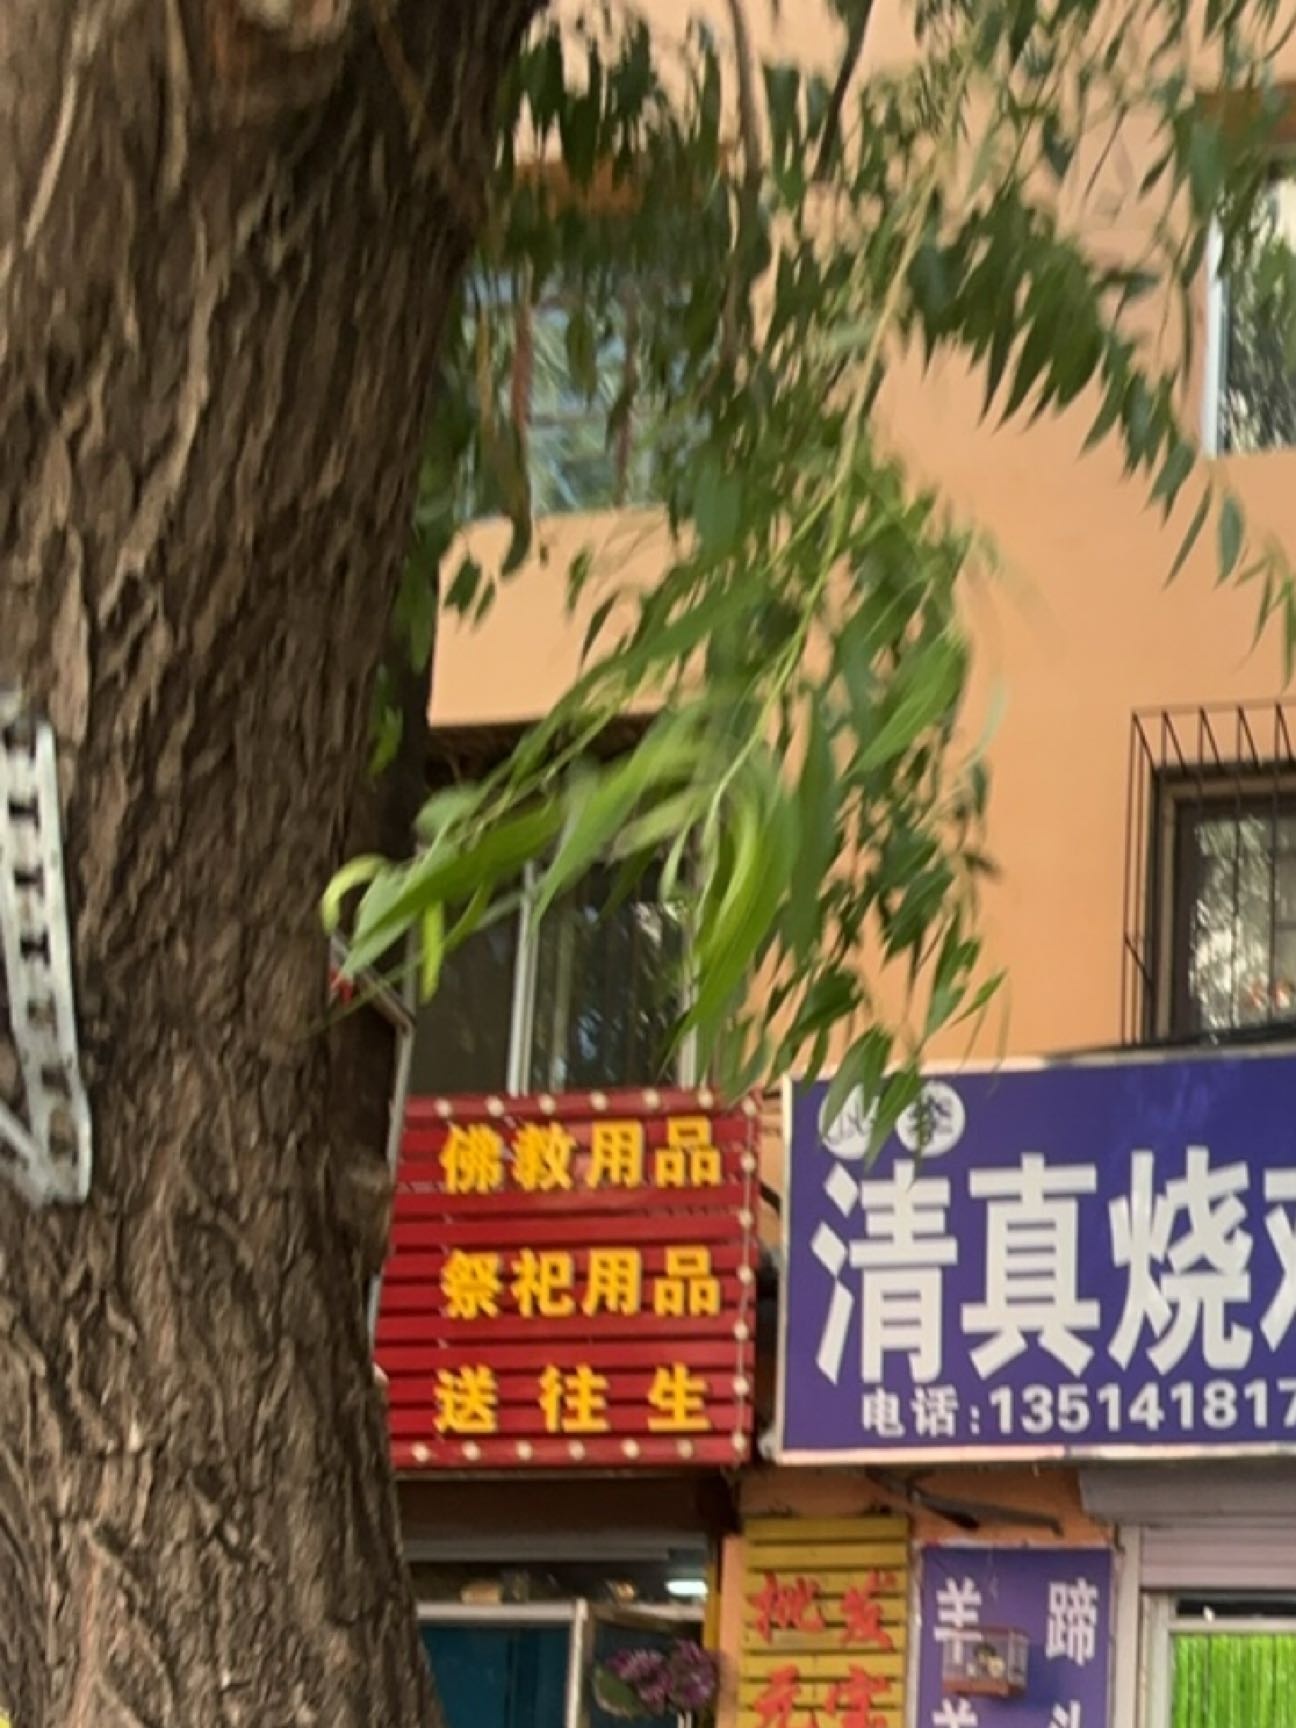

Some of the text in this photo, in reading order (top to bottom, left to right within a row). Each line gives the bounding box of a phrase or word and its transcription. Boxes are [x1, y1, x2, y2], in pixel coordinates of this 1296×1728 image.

[440, 1116, 722, 1194] 佛教用品
[440, 1246, 721, 1320] 祭祀用品
[434, 1364, 712, 1434] 送往生
[934, 1576, 1098, 1667] 羊蹄
